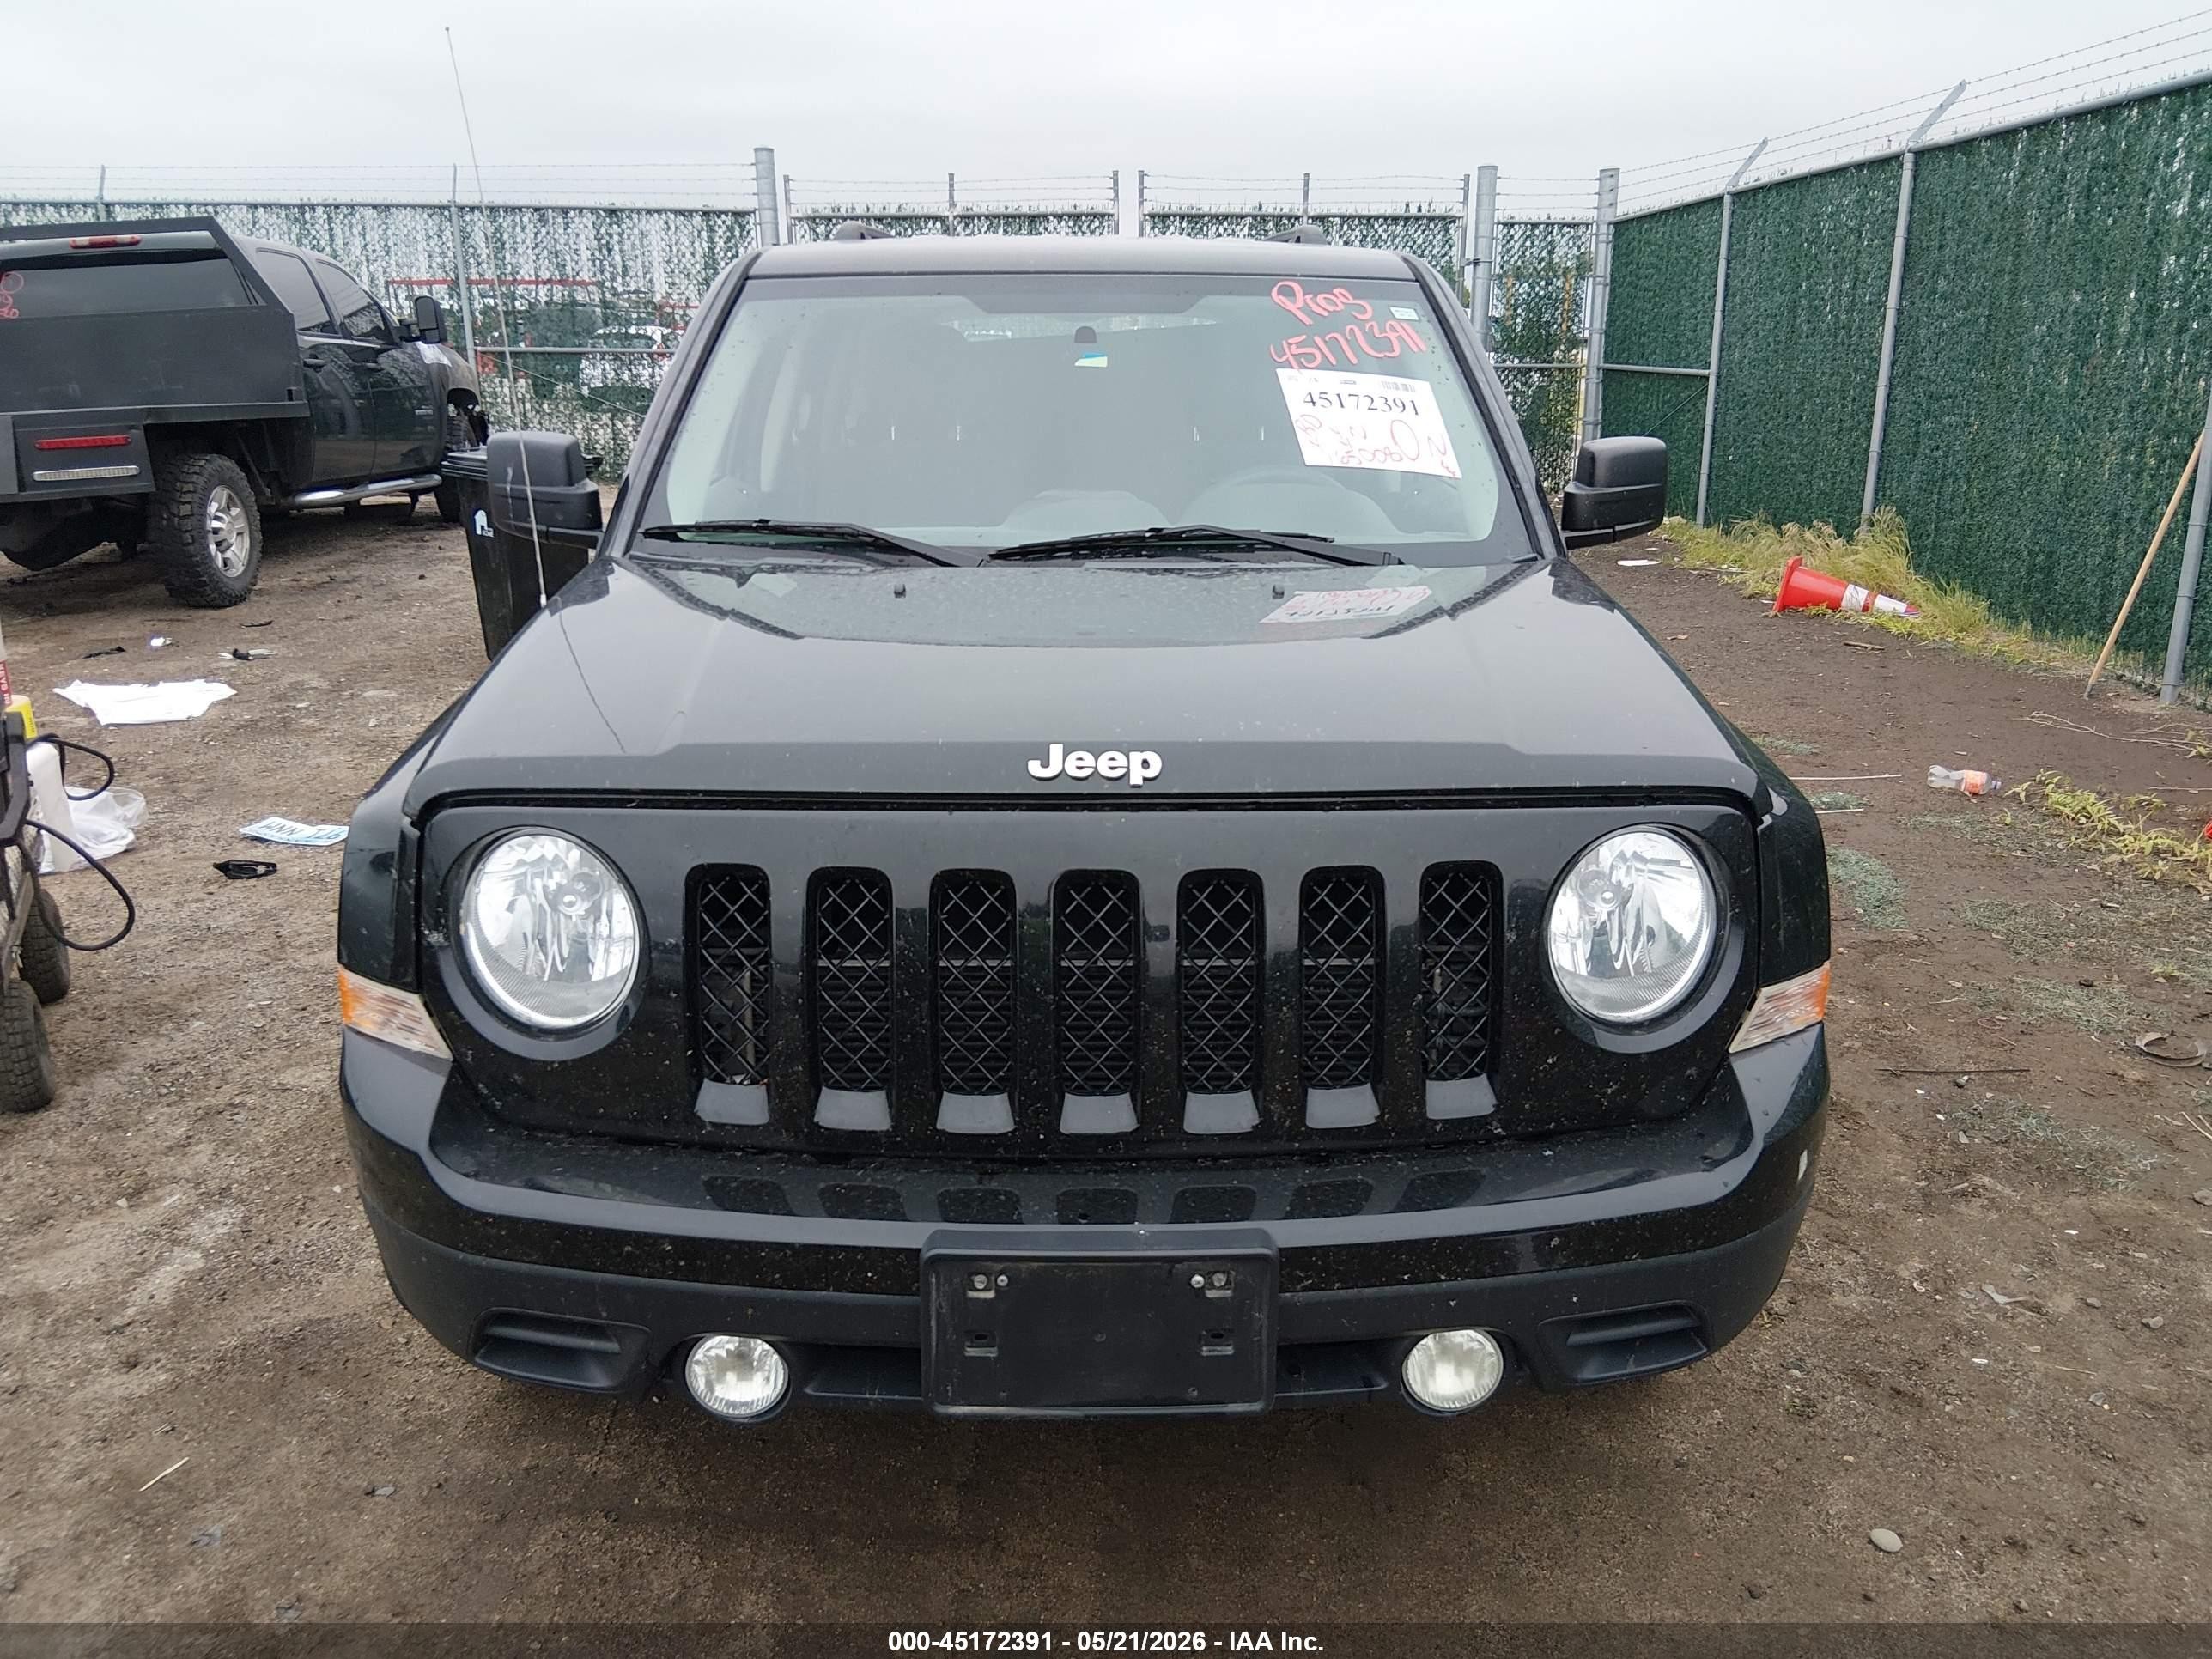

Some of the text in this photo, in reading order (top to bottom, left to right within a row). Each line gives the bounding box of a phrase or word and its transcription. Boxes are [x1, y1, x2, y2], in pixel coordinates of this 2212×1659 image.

[1270, 320, 1427, 371] 45172391
[1304, 391, 1419, 416] 45172391
[1027, 743, 1163, 788] Jeep
